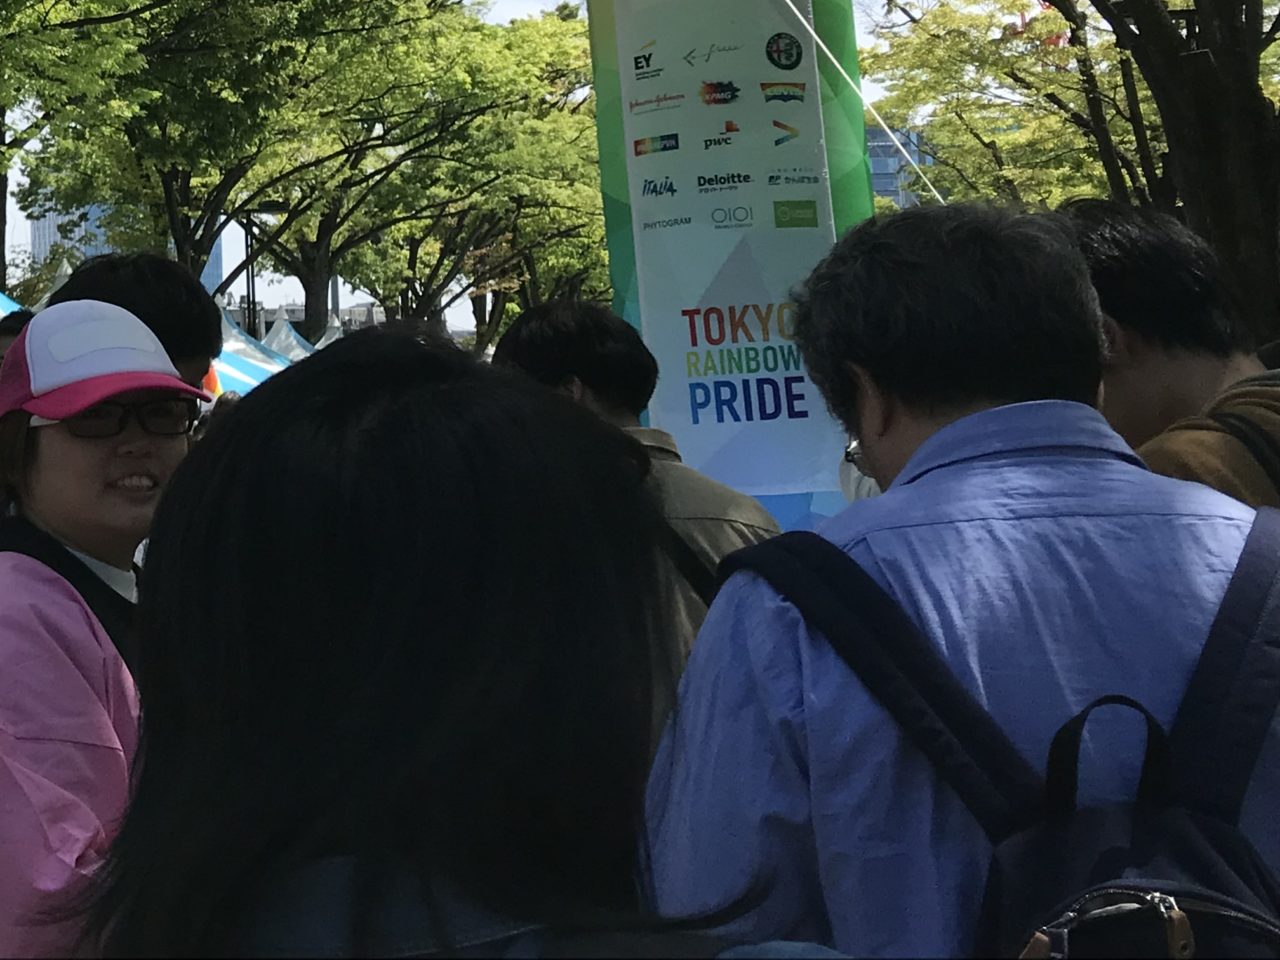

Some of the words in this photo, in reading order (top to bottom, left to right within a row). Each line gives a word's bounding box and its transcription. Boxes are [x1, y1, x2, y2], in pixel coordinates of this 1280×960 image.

[633, 53, 653, 71] EY
[643, 216, 693, 232] PHYTOGRAM
[681, 303, 799, 347] TOKYO
[686, 344, 802, 378] RAINBOW
[688, 376, 809, 425] PRIDE
